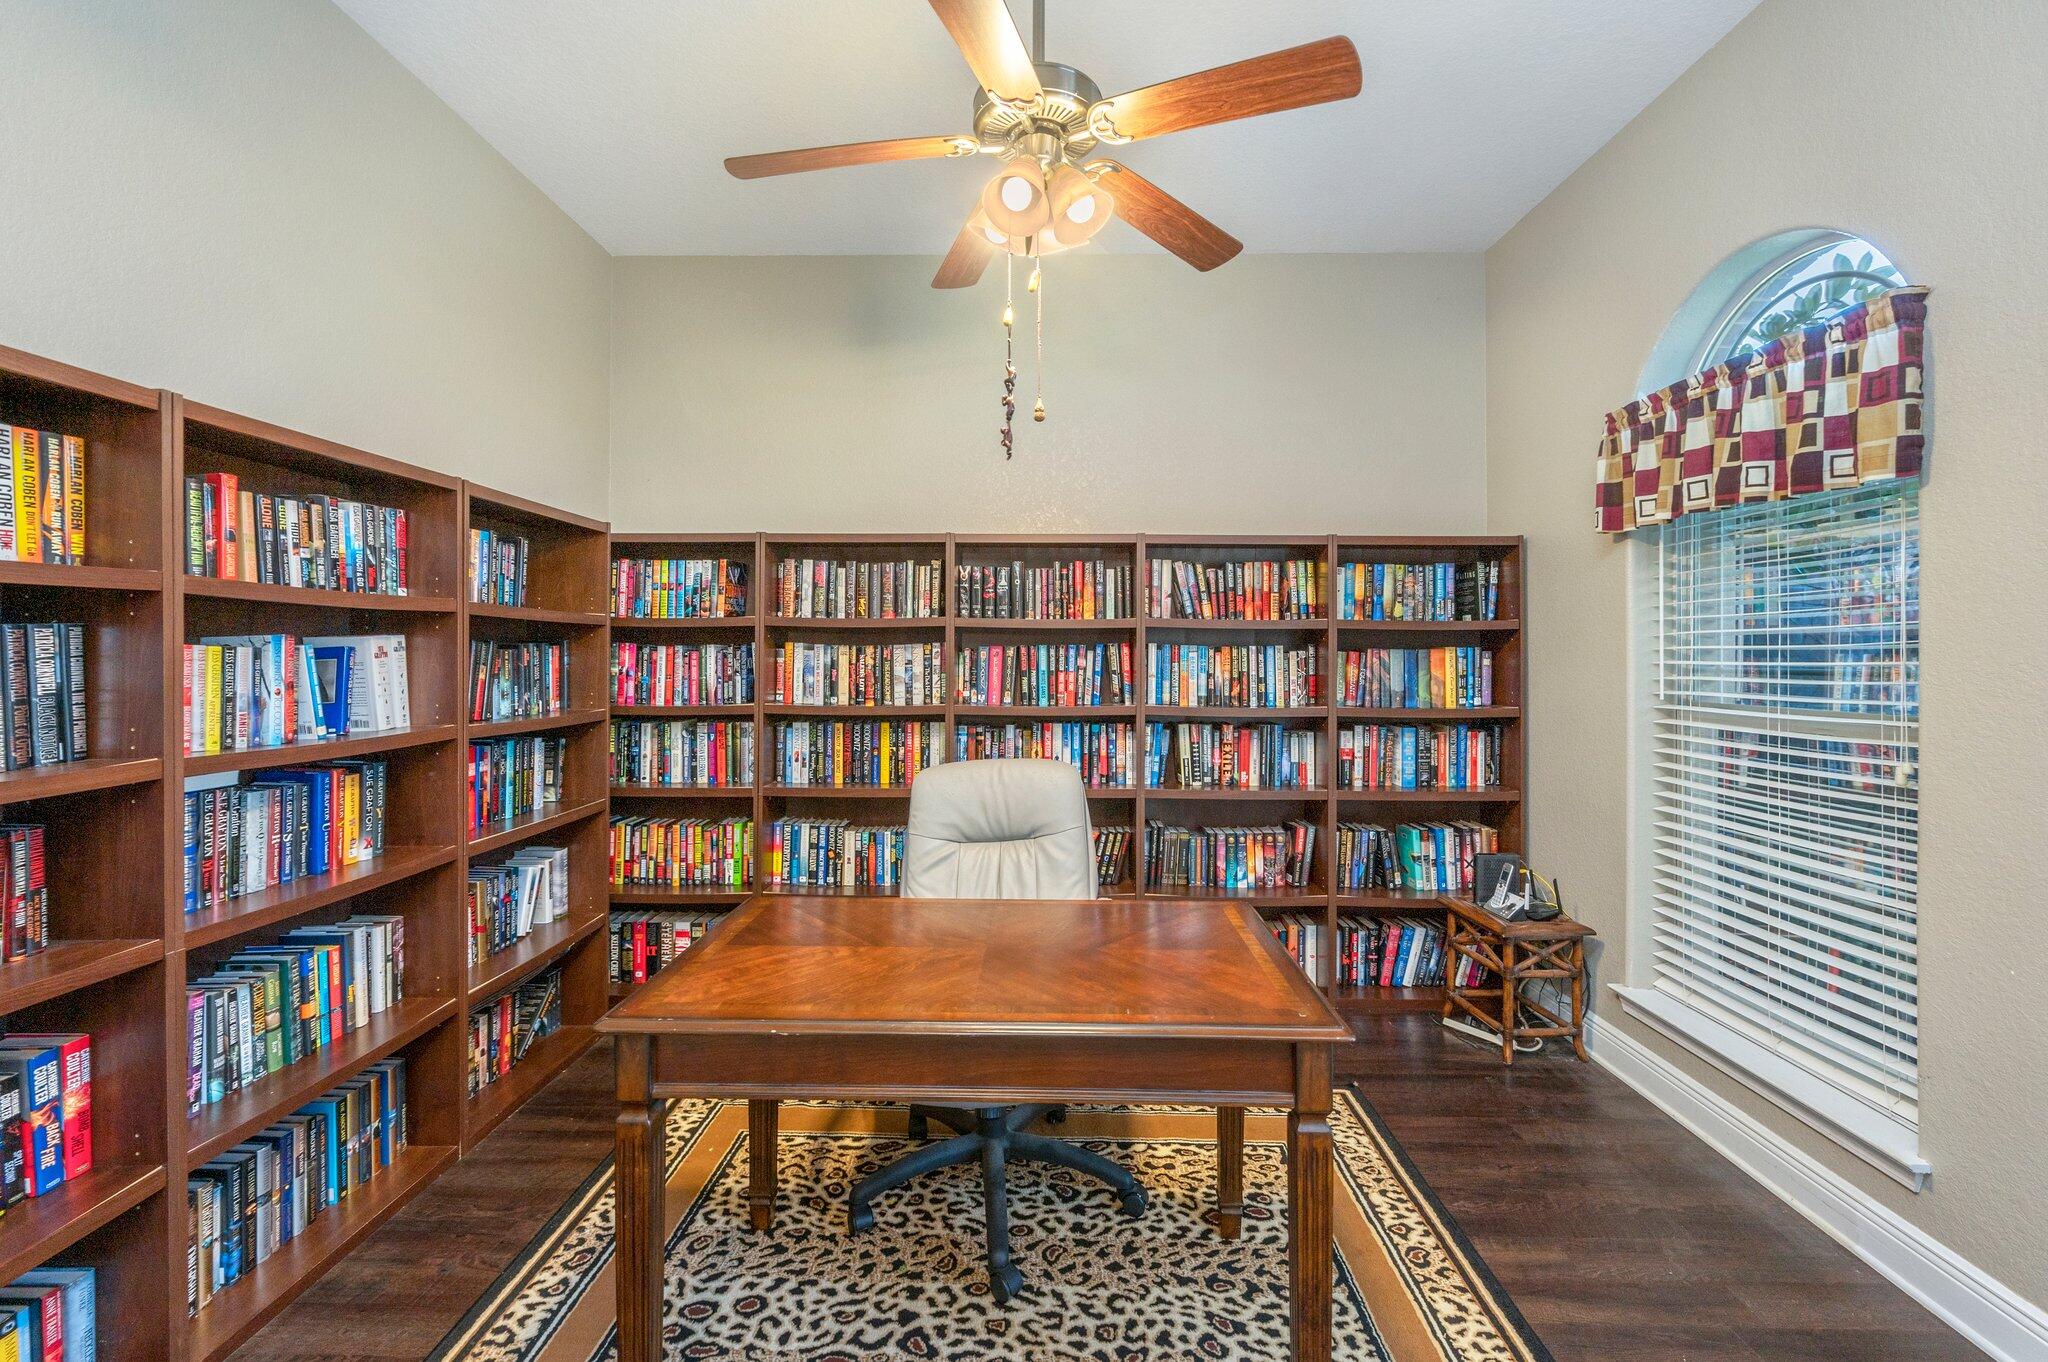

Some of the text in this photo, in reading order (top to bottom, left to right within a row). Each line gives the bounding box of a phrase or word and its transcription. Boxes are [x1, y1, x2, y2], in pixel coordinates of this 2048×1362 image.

[22, 432, 34, 472] HARLAN
[0, 429, 14, 550] HARLAN COBEN HOME
[23, 475, 36, 508] COBEN
[70, 456, 83, 495] HARLAN
[48, 438, 62, 555] HARLAN COBEN RUN AWAY
[71, 499, 84, 530] COBEN
[262, 498, 272, 528] ALONE
[278, 505, 287, 530] GONE
[27, 533, 36, 545] LET
[70, 534, 84, 555] WIN
[291, 522, 299, 544] HIDE
[330, 506, 339, 558] LISA GARDNER
[356, 578, 364, 587] GO
[7, 630, 25, 664] PATRICIA
[69, 627, 83, 656] PATRICIA
[212, 650, 220, 663] TESS
[226, 650, 234, 663] TESS
[10, 664, 27, 702] CORNWELL
[70, 658, 84, 691] CORNWELL
[212, 663, 220, 698] GERRITSEN
[226, 664, 234, 697] GERRITSEN
[34, 628, 58, 759] PATRICIA CORNWELL BLACK NOTICE
[72, 692, 85, 703] THE
[72, 704, 86, 720] LAST
[238, 713, 247, 738] VANISH
[16, 728, 29, 737] of
[73, 721, 87, 752] PRECINCT
[1223, 743, 1233, 775] EXILE
[231, 790, 240, 836] Sue Grafton
[366, 770, 374, 831] SUE GRAFTON
[202, 794, 213, 873] SUE GRAFTON M
[218, 790, 227, 851] SUE GRAFTON
[300, 823, 308, 831] T
[322, 822, 330, 831] U
[272, 835, 281, 844] R
[283, 833, 293, 841] S
[611, 934, 620, 976] SKELETON CREW
[661, 922, 670, 962] STEPHEN
[292, 963, 301, 1008] THE FIRM
[192, 1009, 203, 1067] HEATHER GRAHAM
[47, 1060, 59, 1099] CATHERINE
[66, 1052, 80, 1093] COULTER
[81, 1047, 90, 1085] CATHERINE
[34, 1066, 47, 1106] COULTER
[11, 1089, 20, 1116] CATHERINE
[46, 1123, 60, 1148] BACK
[78, 1109, 90, 1132] BOMB
[13, 1150, 23, 1166] SPLIT
[41, 1148, 55, 1170] FIRE
[71, 1134, 84, 1157] SHELL
[4, 1161, 15, 1183] SECOND
[202, 1187, 212, 1238] JOHN GRISHAM
[188, 1266, 196, 1302] GRISHAM
